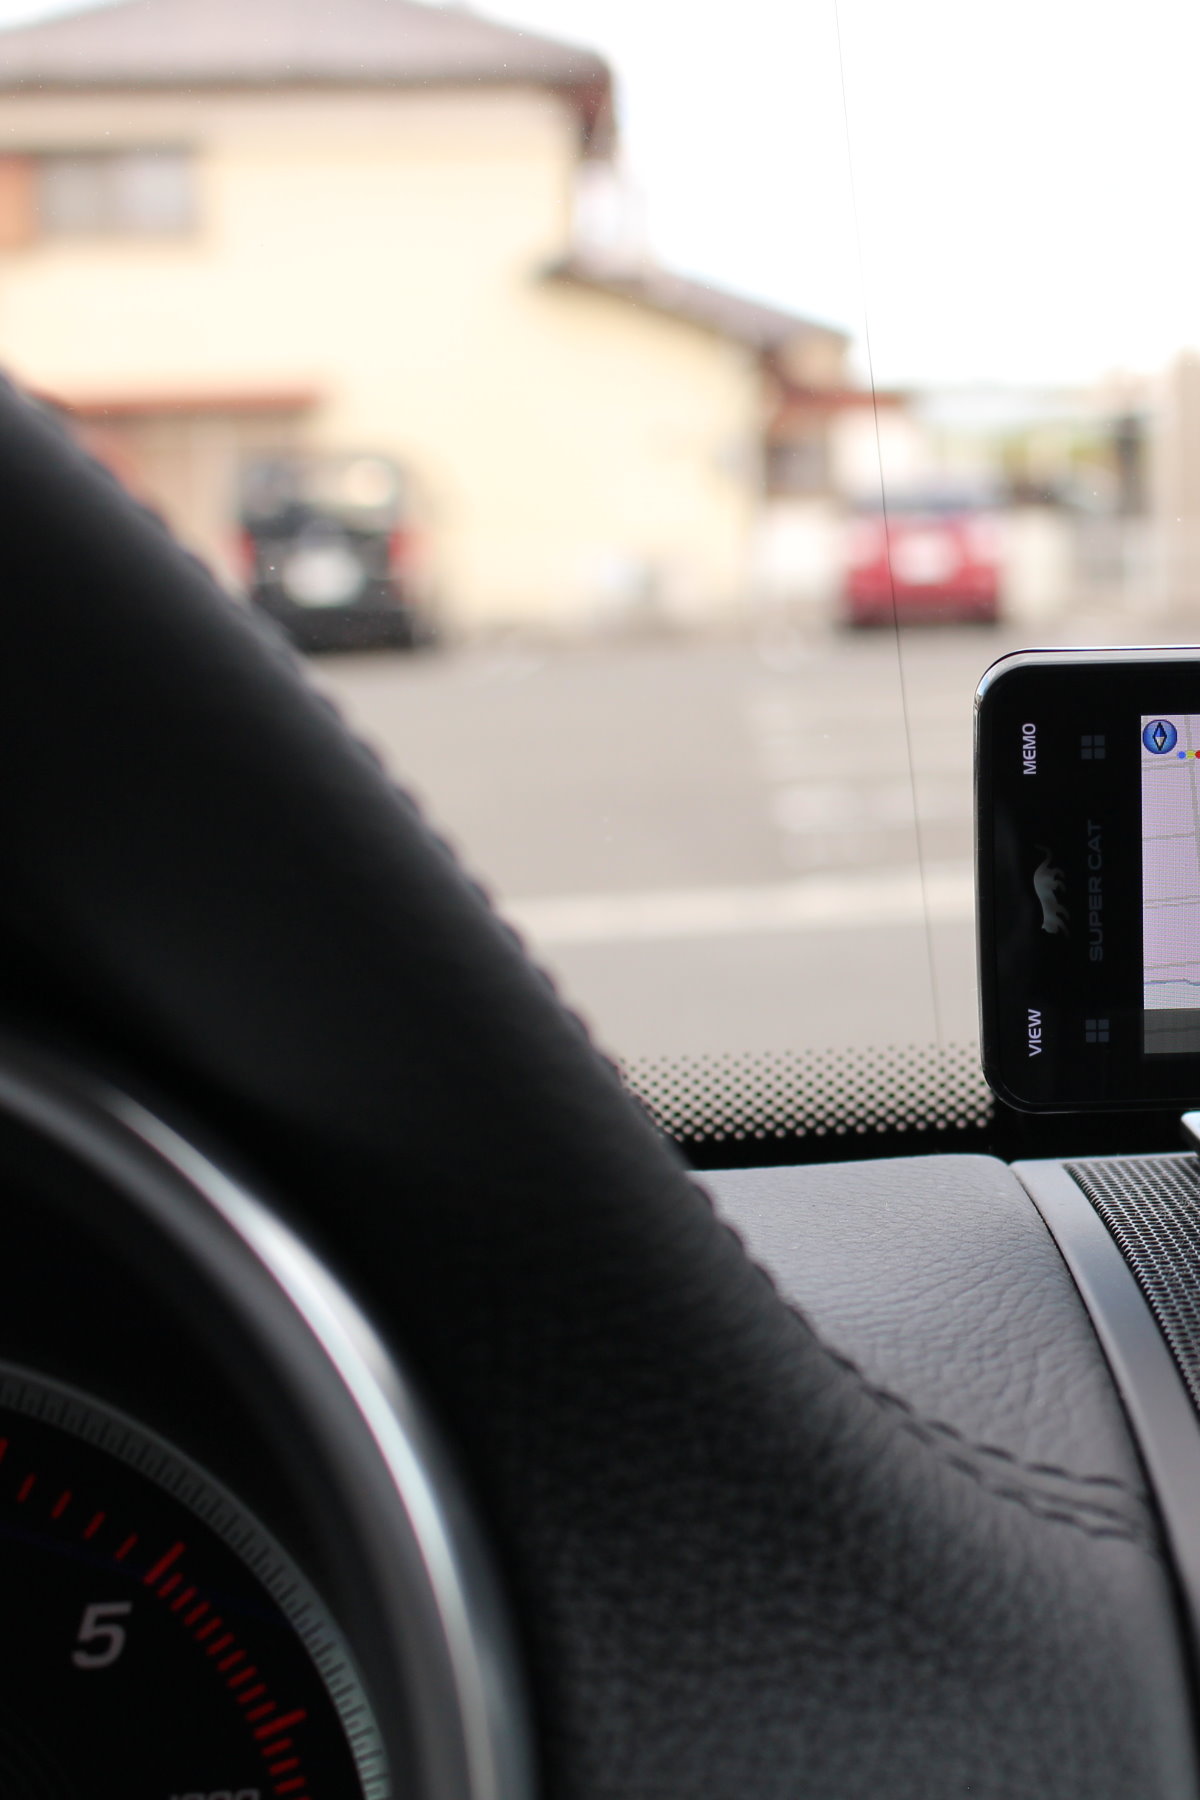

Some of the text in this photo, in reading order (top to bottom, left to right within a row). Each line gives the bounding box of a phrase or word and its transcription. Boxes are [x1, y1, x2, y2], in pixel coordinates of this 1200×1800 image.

[1023, 722, 1037, 775] MEMO
[1087, 819, 1104, 962] SUPER CAT
[1029, 1008, 1042, 1057] VIEW
[71, 1602, 131, 1669] 5
